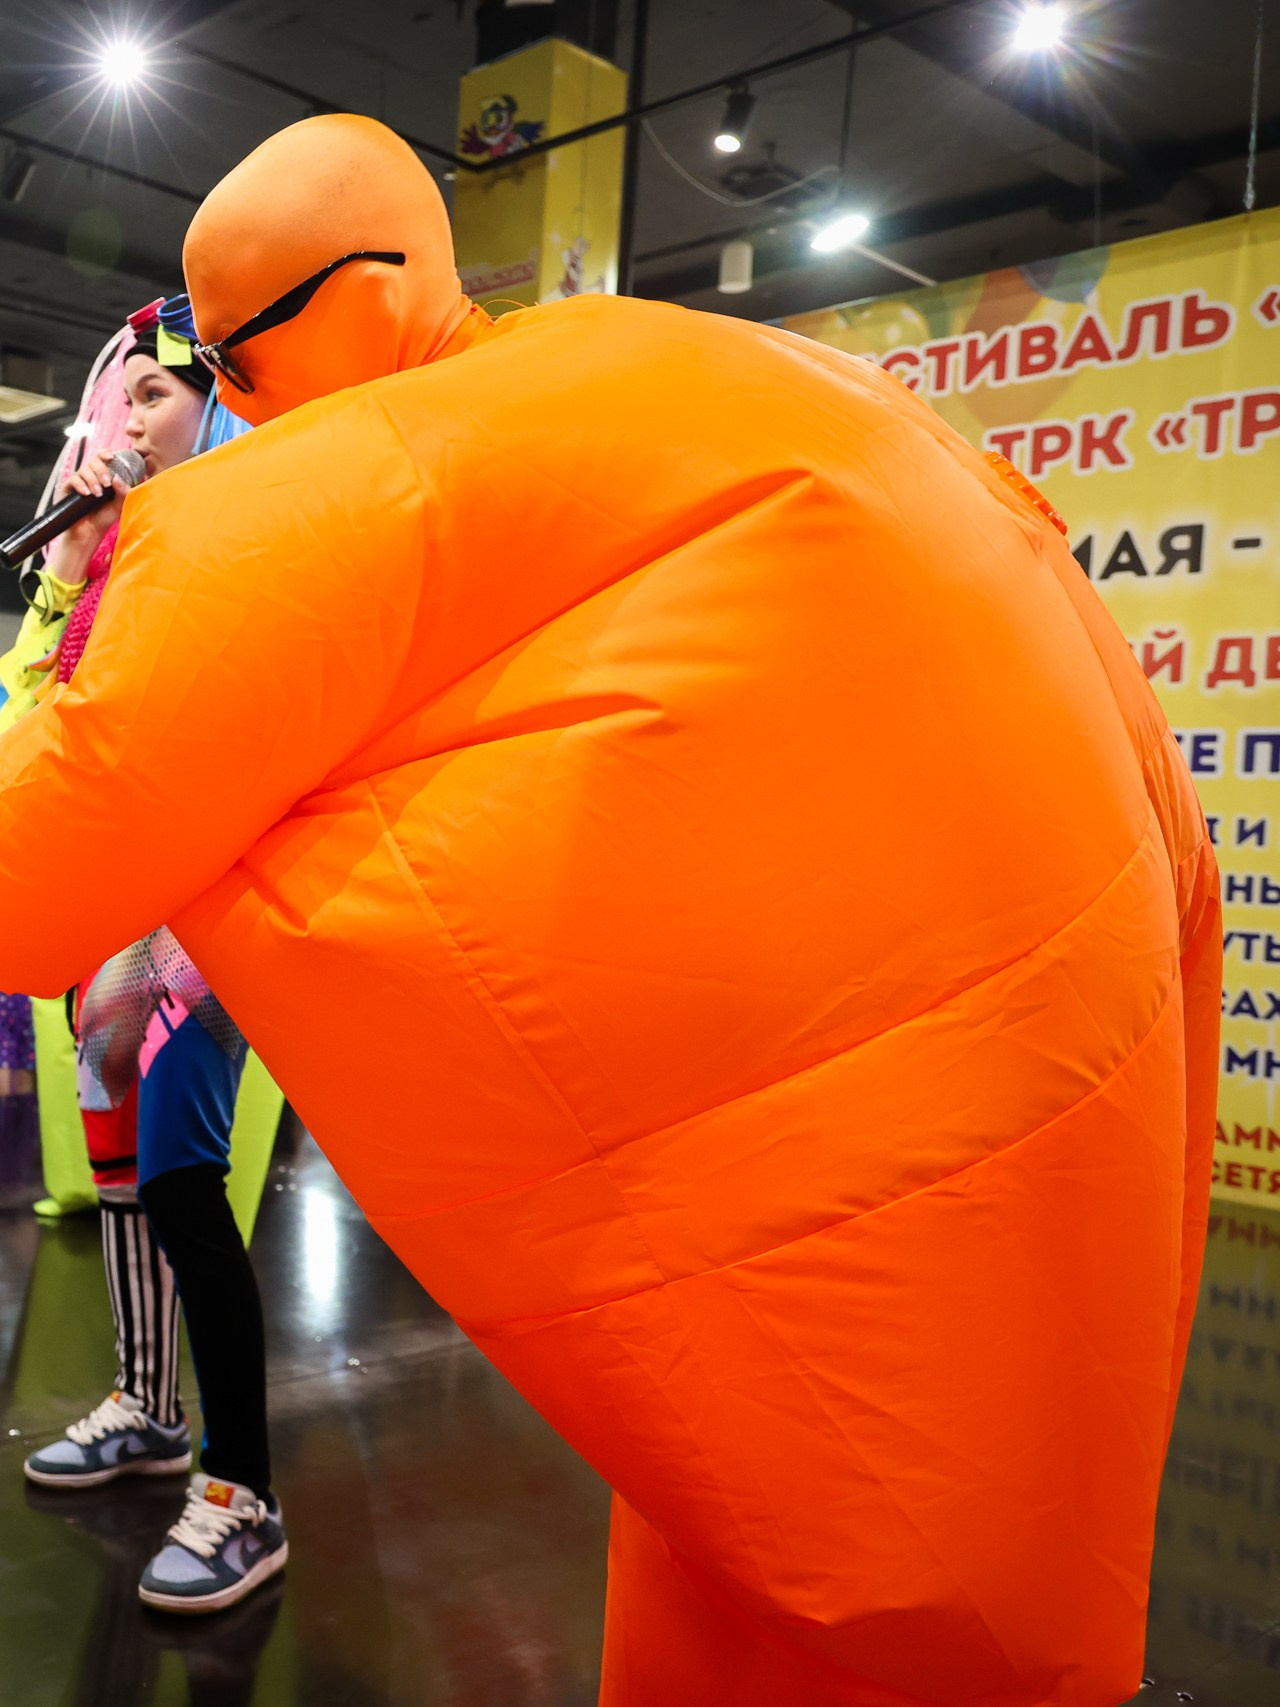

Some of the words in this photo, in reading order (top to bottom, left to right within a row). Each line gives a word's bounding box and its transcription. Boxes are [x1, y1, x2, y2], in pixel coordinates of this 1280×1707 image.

[866, 294, 1230, 392] СТИВАЛЬ
[990, 414, 1128, 476] ТРК
[1155, 392, 1280, 454] «ТР
[1129, 630, 1184, 683] Й
[1174, 734, 1218, 772] Е
